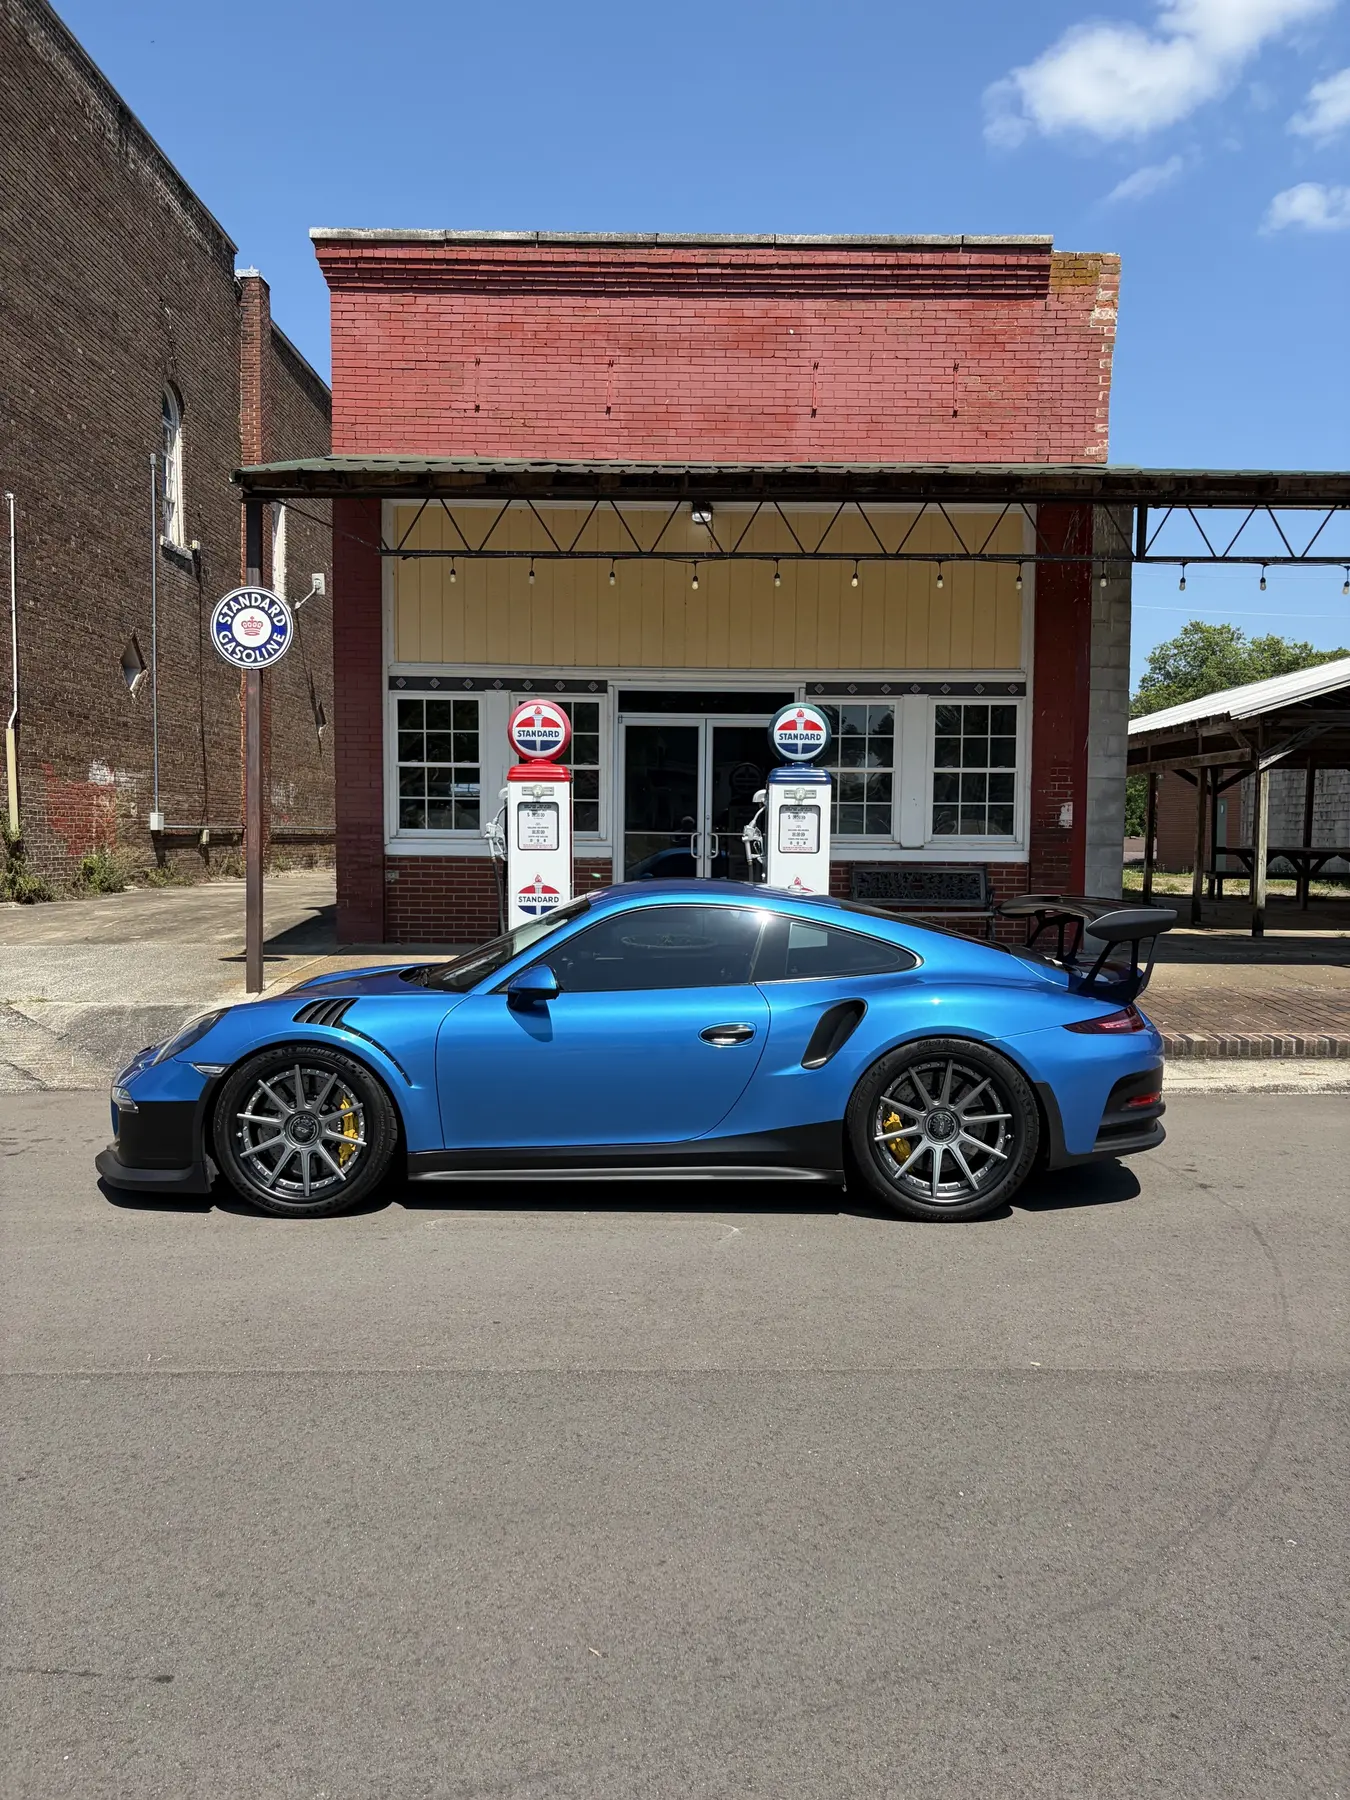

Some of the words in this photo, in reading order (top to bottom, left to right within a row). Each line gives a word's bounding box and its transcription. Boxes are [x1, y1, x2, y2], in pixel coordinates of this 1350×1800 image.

[219, 593, 286, 627] STANDARD
[219, 631, 285, 662] GASOLINE
[517, 730, 560, 738] STANDARD
[778, 733, 822, 741] STANDARD
[518, 895, 560, 903] STANDARD
[296, 1046, 348, 1065] MICHELIN
